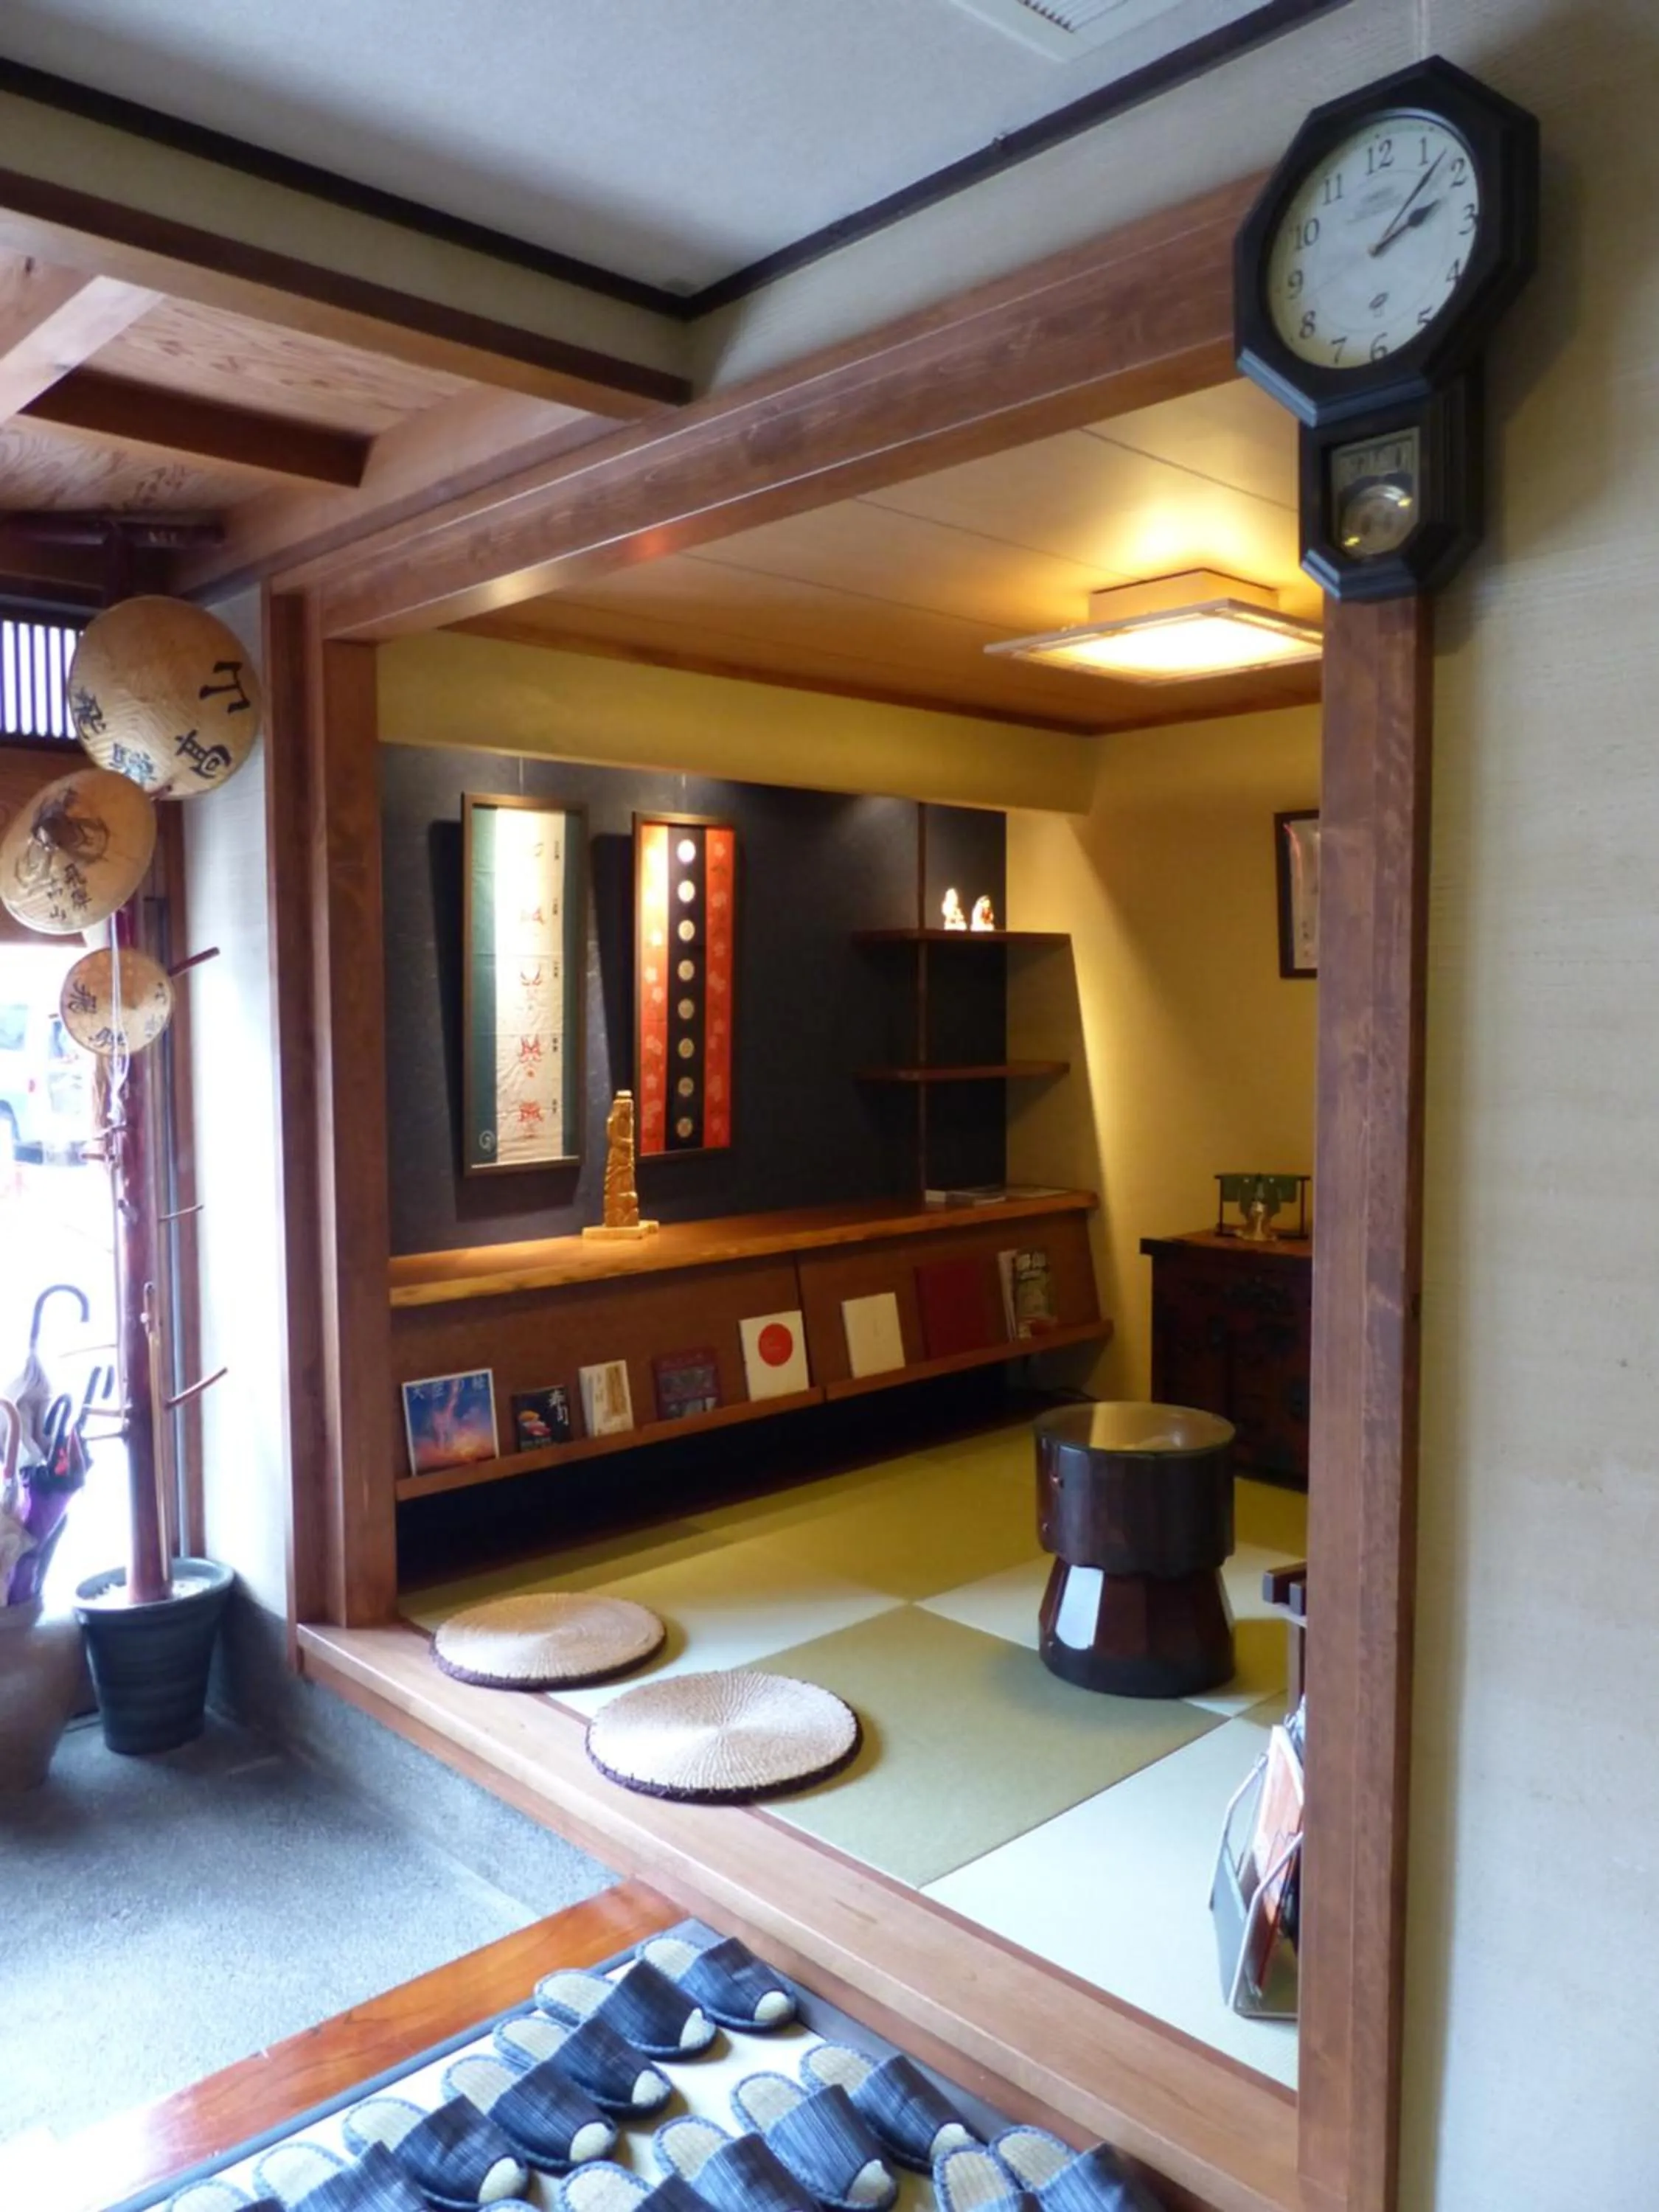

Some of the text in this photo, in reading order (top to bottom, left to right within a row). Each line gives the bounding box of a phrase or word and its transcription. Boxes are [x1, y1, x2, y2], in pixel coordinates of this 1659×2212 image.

[1364, 138, 1395, 176] 12
[1417, 136, 1429, 167] 1
[1450, 157, 1468, 188] 2
[1322, 173, 1343, 206] 11
[1290, 217, 1320, 251] 10
[1458, 203, 1477, 236] 3
[1287, 269, 1304, 300] 9
[1445, 258, 1460, 284] 4
[1299, 310, 1316, 340] 8
[1330, 335, 1349, 364] 7
[1369, 332, 1388, 362] 6
